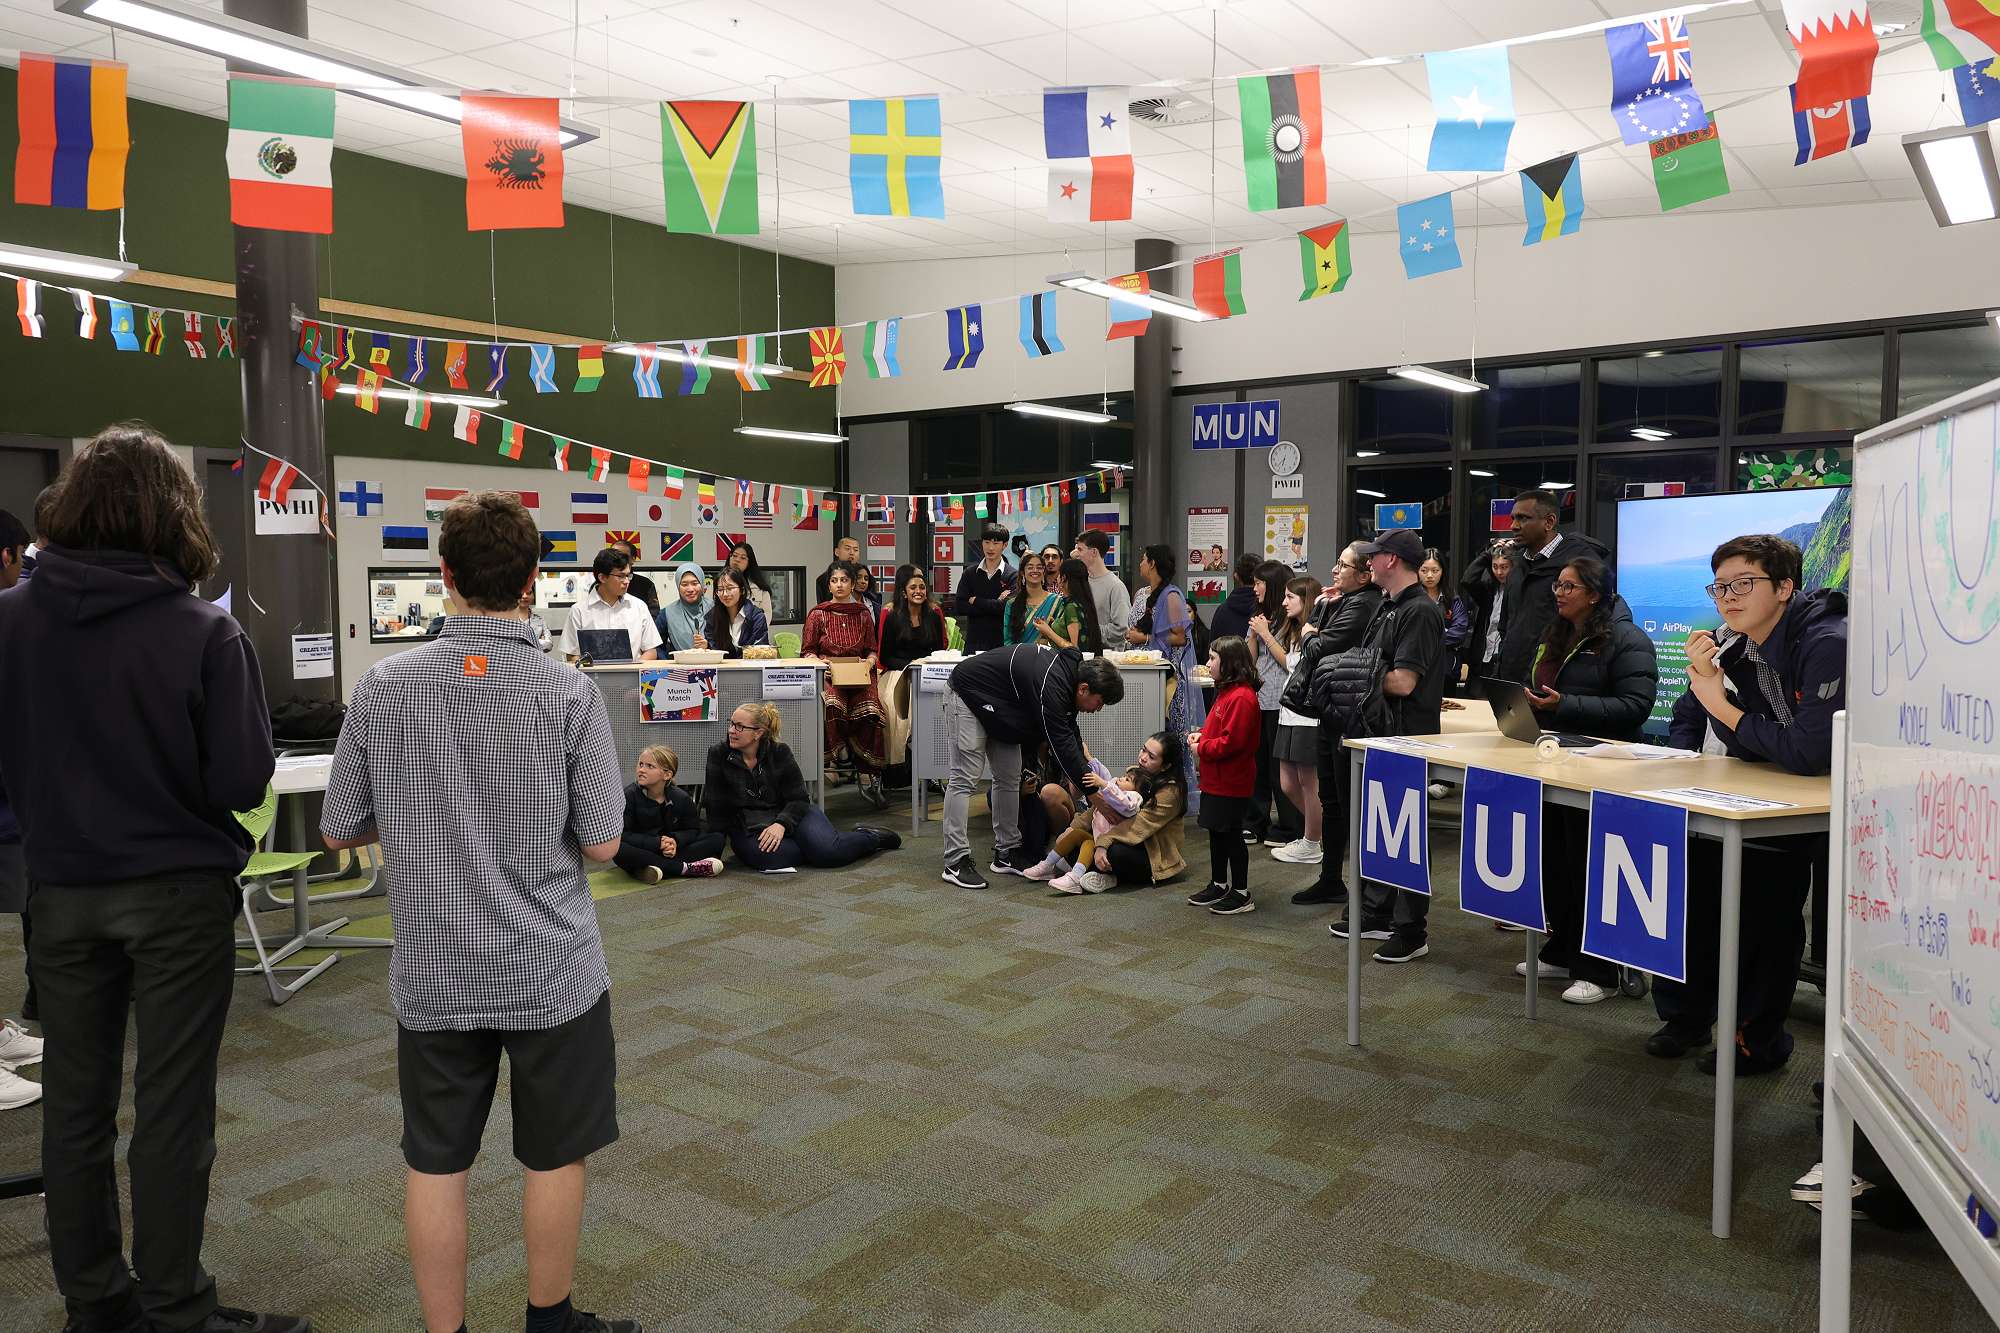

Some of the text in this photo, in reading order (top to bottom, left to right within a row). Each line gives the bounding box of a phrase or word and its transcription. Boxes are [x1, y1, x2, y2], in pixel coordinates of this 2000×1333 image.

[1195, 409, 1275, 441] MUN
[1662, 622, 1692, 634] AirPlay
[1667, 690, 1681, 698] THIS
[1664, 700, 1673, 708] TV
[1899, 683, 1994, 747] MODEL UNITED
